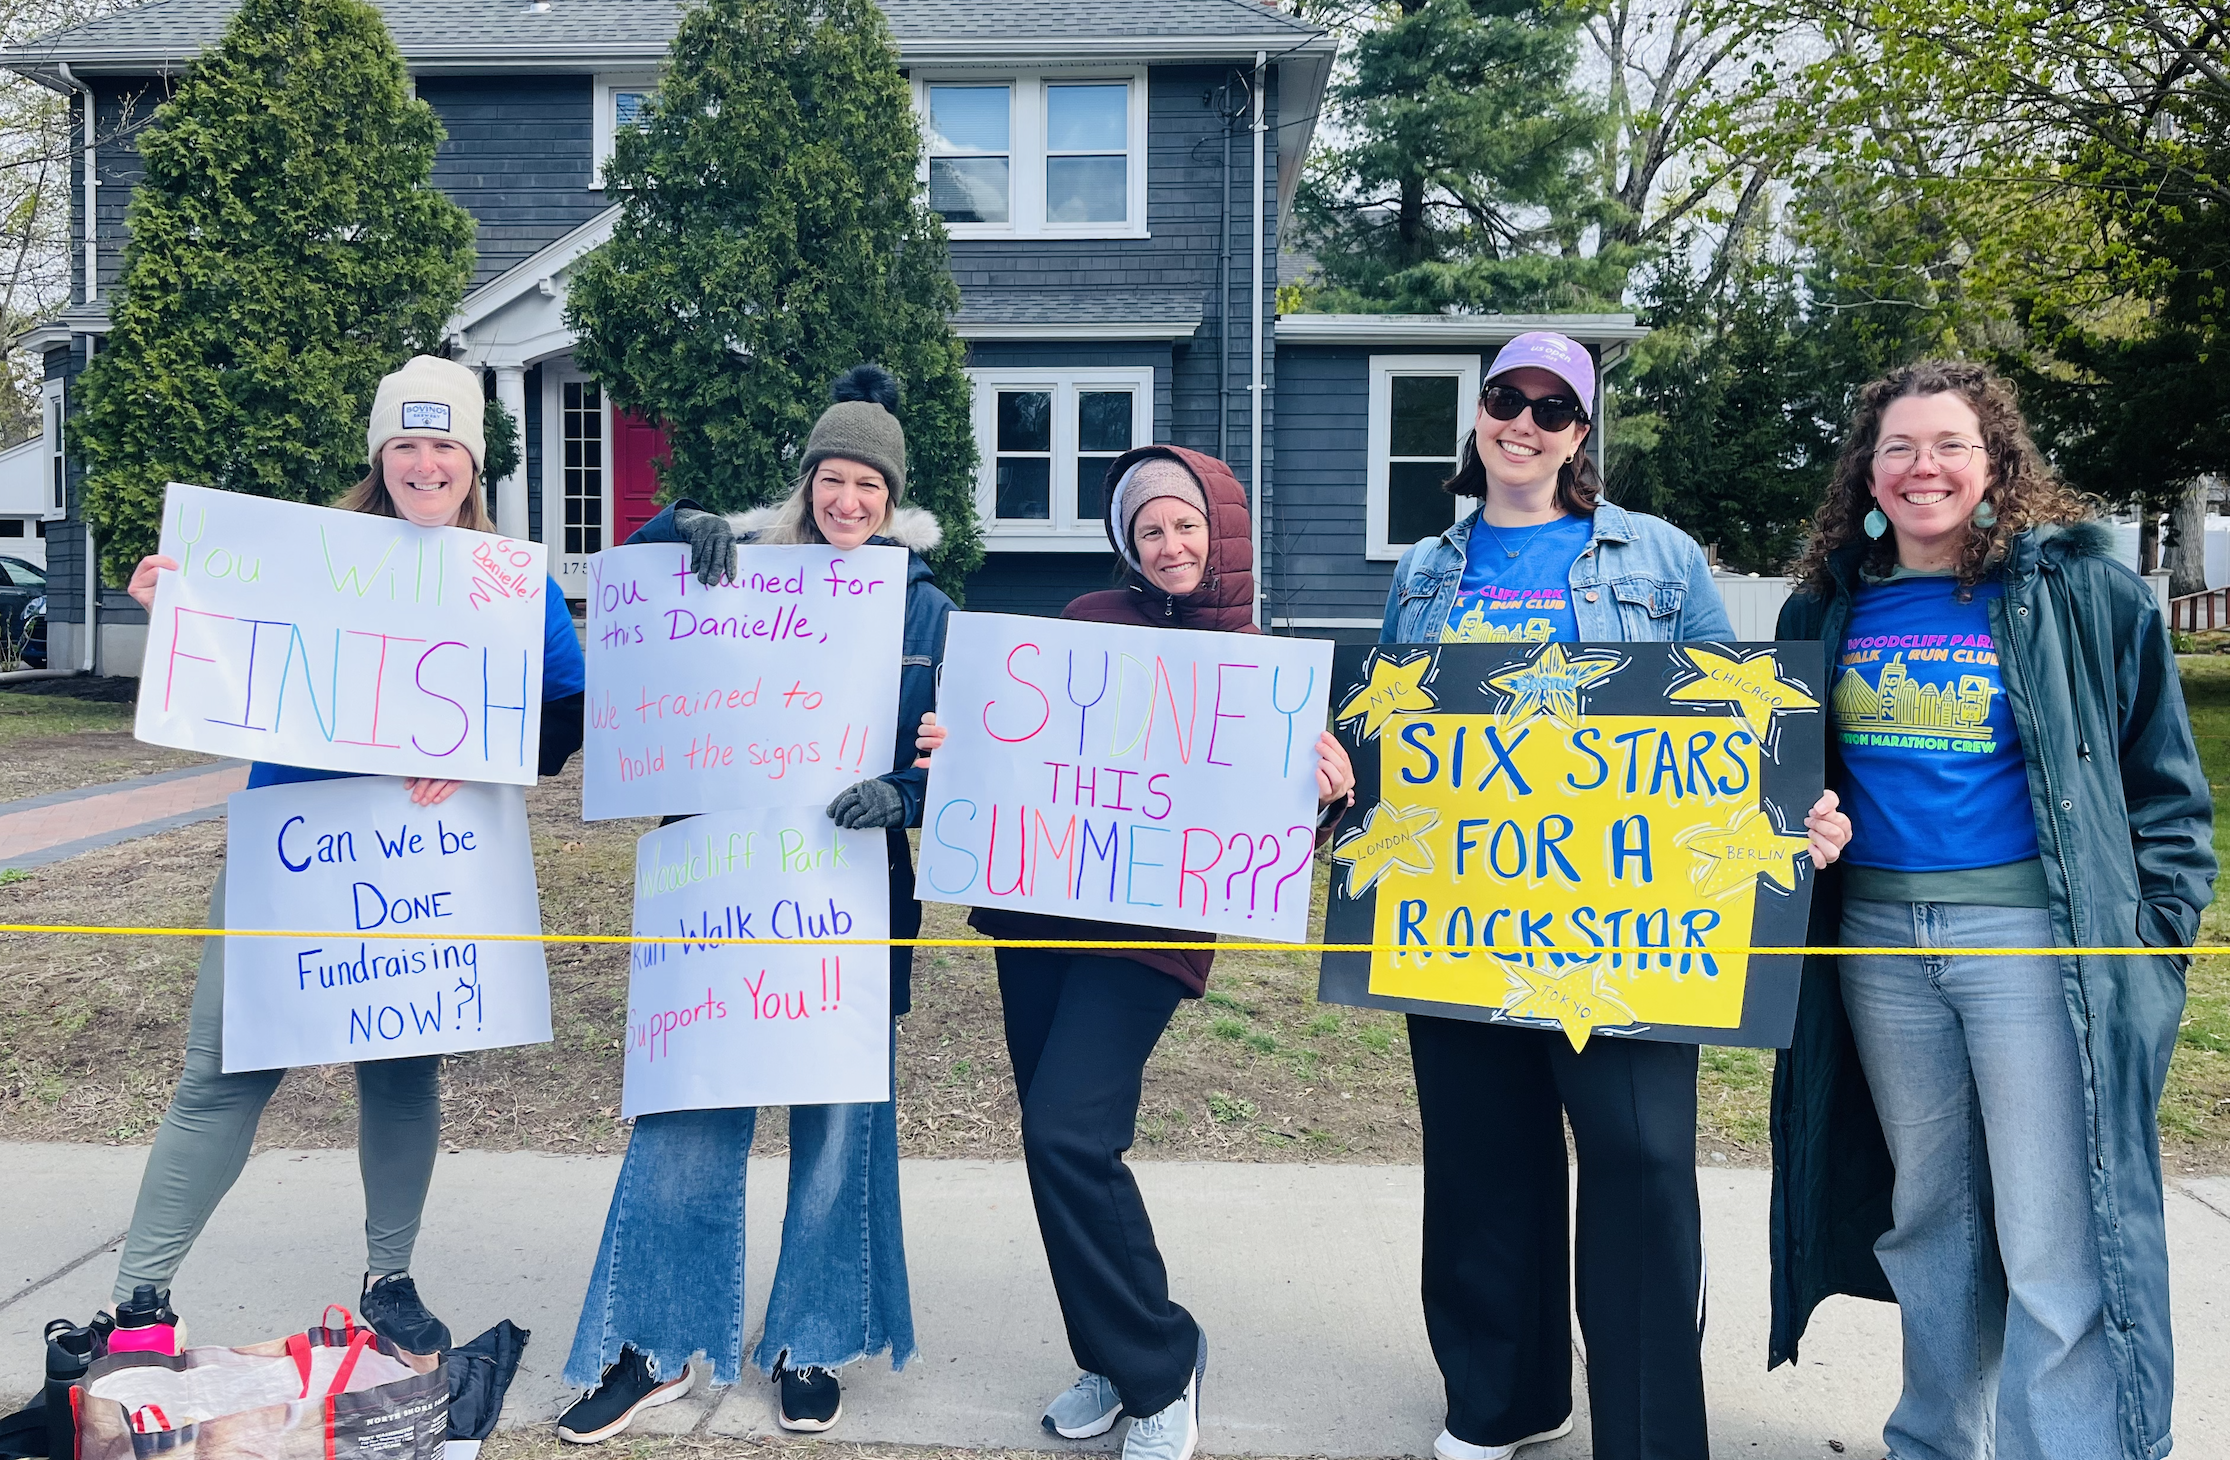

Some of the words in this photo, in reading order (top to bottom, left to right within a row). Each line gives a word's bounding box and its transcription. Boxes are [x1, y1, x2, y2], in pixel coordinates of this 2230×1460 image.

[1545, 347, 1572, 363] open
[176, 502, 261, 583] You
[319, 523, 445, 607] Will
[471, 540, 541, 604] Danielle!
[496, 538, 532, 568] GO
[590, 557, 649, 620] You
[672, 553, 805, 597] tained
[823, 558, 885, 597] for
[1457, 585, 1520, 600] CLIFF
[1521, 589, 1565, 600] PARK
[1489, 599, 1522, 610] RUN
[1525, 598, 1566, 610] CLUB
[600, 620, 644, 651] this
[663, 603, 829, 644] Danielle,
[1847, 634, 1948, 650] WOODCLIFF
[1950, 634, 1996, 649] PAR
[1842, 649, 1882, 665] WALK
[1908, 648, 1949, 662] RUN
[163, 606, 528, 768] FINISH
[591, 689, 621, 730] We
[635, 676, 762, 724] trained
[783, 680, 824, 710] to
[1370, 681, 1408, 710] NYC
[1516, 673, 1580, 693] BOSTON
[1711, 668, 1783, 707] CHICAGO
[1881, 676, 1900, 718] 2026
[982, 643, 1314, 779] SYDNEY
[618, 745, 665, 782] hold
[683, 733, 734, 770] the
[1400, 722, 1533, 796] SIX
[1566, 726, 1752, 799] STARS
[1840, 733, 1869, 745] STON
[1871, 734, 1949, 751] MARATHON
[1951, 739, 1997, 753] CREW
[1043, 761, 1172, 820] THIS
[277, 815, 357, 873] Can
[438, 820, 478, 856] be
[637, 830, 759, 900] Woodcliff
[778, 828, 851, 874] Park
[928, 798, 1315, 922] SUMMER???
[1357, 829, 1410, 860] LONDON
[1456, 813, 1582, 883] FOR
[1611, 813, 1654, 884] A
[1725, 845, 1786, 860] BERLIN
[352, 882, 453, 931] DONE
[632, 930, 666, 975] Run
[679, 905, 757, 956] Walk
[771, 898, 853, 940] Club
[1398, 898, 1722, 977] ROCKSTAR
[297, 942, 478, 991] Fundraising
[349, 978, 483, 1045] NOW?!
[626, 987, 728, 1064] Supports
[1540, 984, 1592, 1019] TOKYO
[366, 1412, 401, 1426] NORTH
[403, 1403, 433, 1417] SHORE
